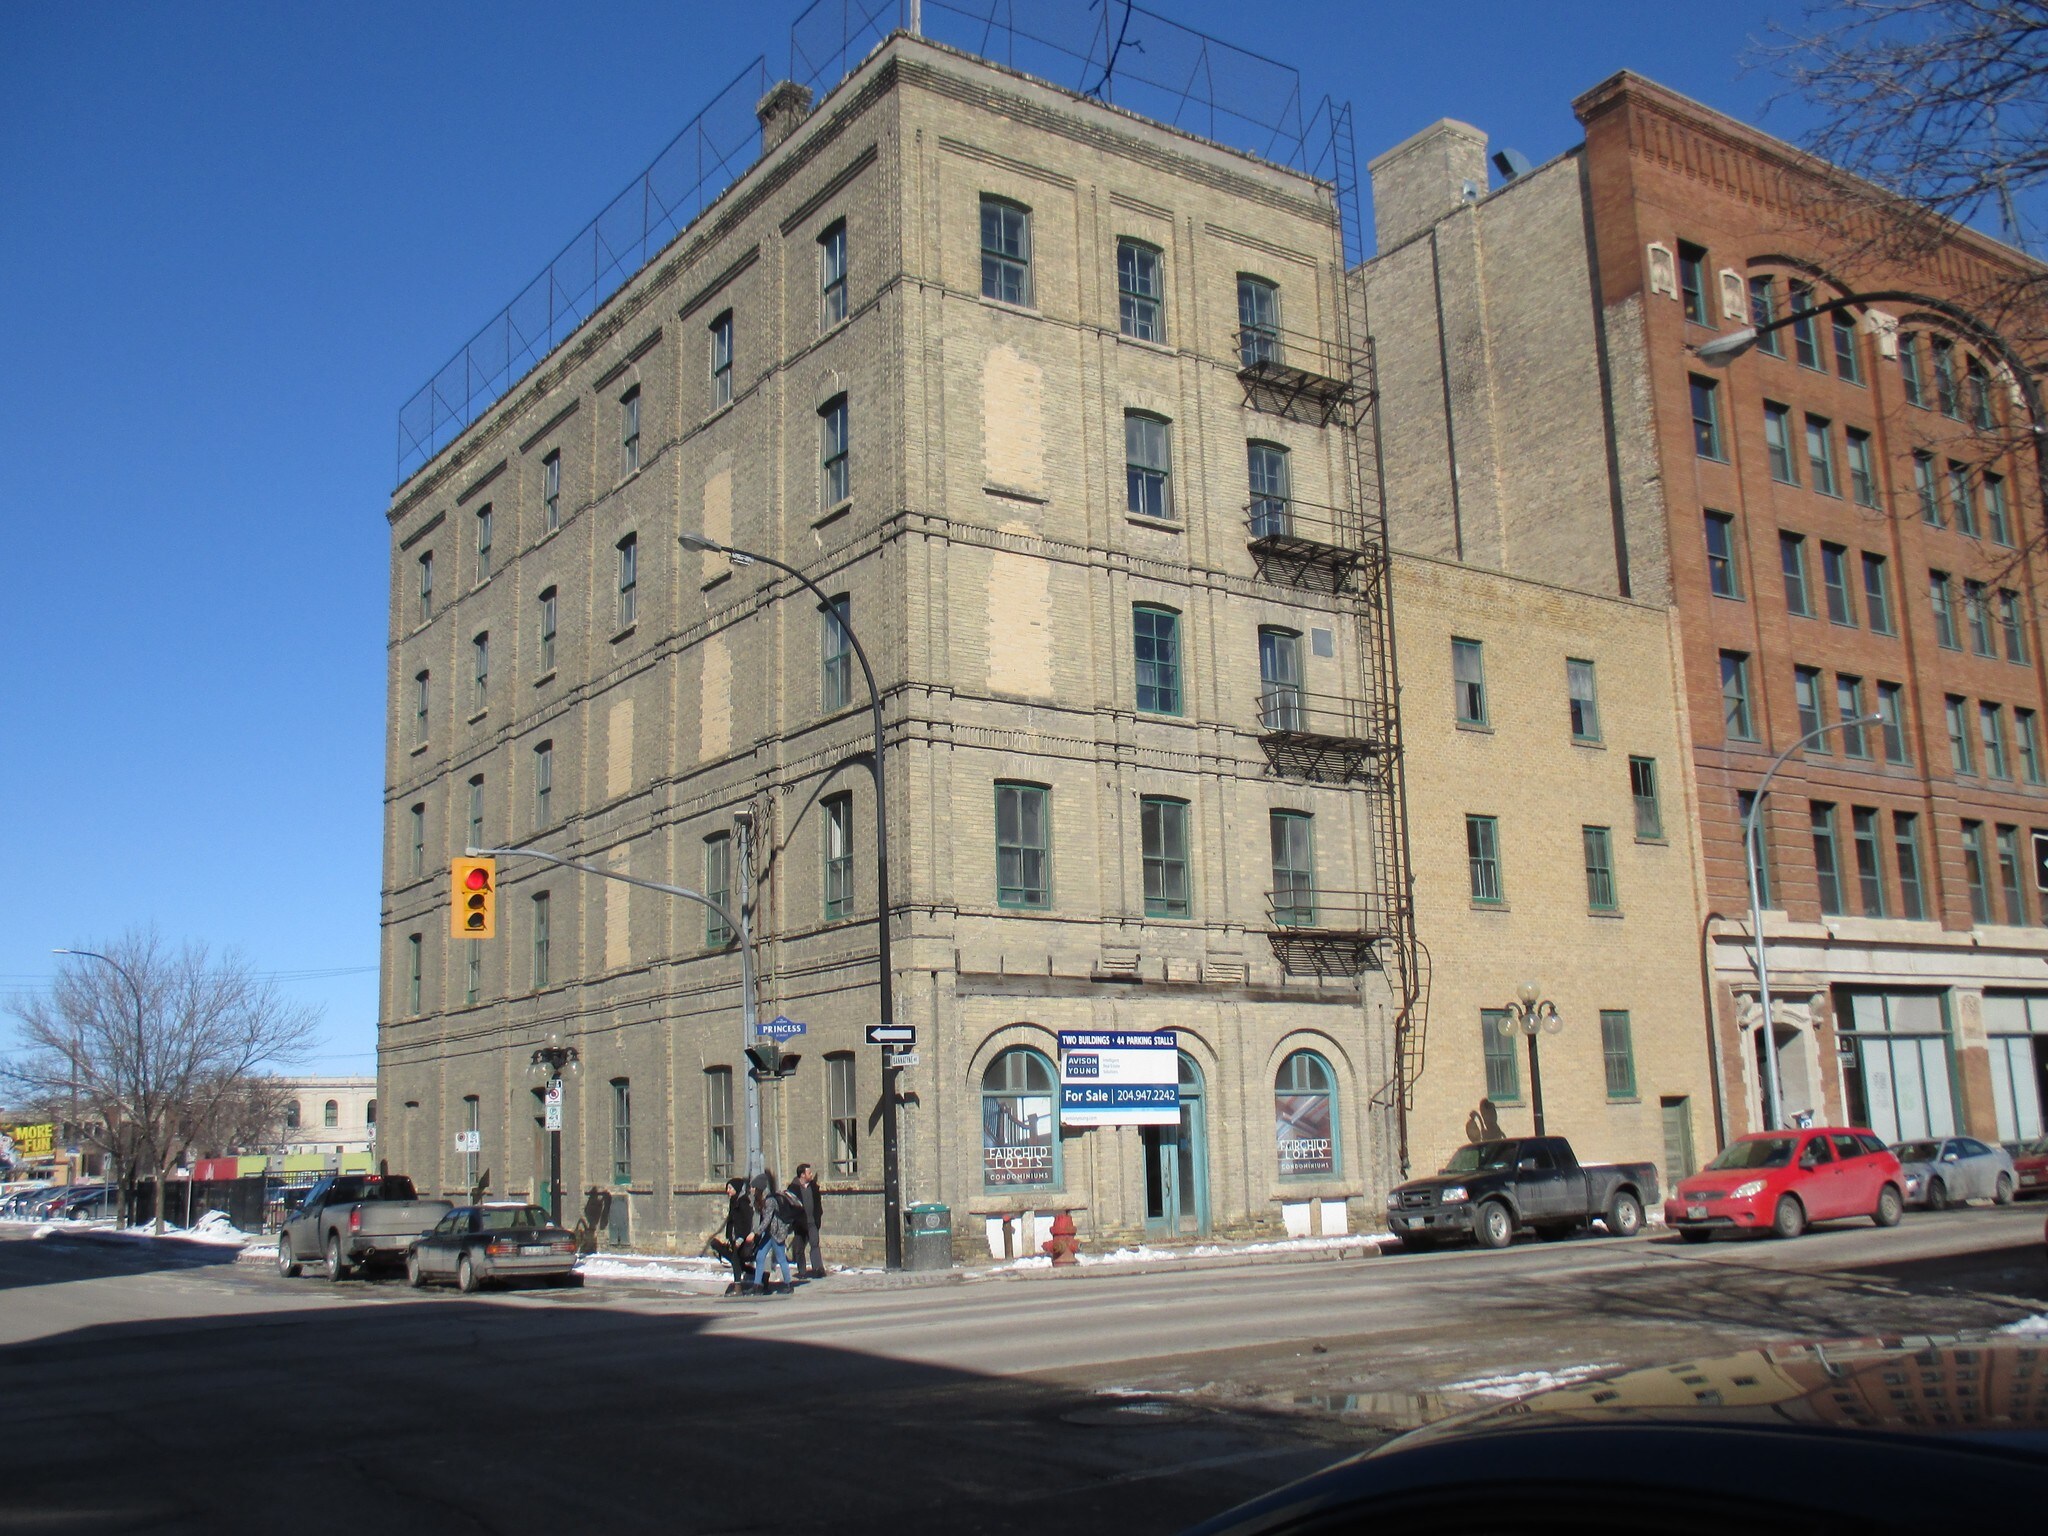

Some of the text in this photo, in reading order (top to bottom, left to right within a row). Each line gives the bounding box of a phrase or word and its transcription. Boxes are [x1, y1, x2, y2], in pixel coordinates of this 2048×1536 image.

[763, 1025, 801, 1033] PRINCESS
[1062, 1035, 1174, 1046] TWO BUILDINGS 44 PARKING STALLS
[1068, 1057, 1097, 1065] AVISON
[1068, 1067, 1097, 1075] YOUNG
[1065, 1089, 1175, 1102] For Sale 204.947.2242
[16, 1123, 53, 1140] MORE
[25, 1137, 51, 1152] FUN
[1280, 1139, 1328, 1150] FAIRCHILD
[990, 1147, 1048, 1159] FAIRCHILD
[1285, 1149, 1324, 1160] LOFTS
[995, 1156, 1043, 1169] LOFTS
[1281, 1162, 1329, 1170] CONDOMINIUMS
[990, 1172, 1048, 1181] CONDOMINIUMS
